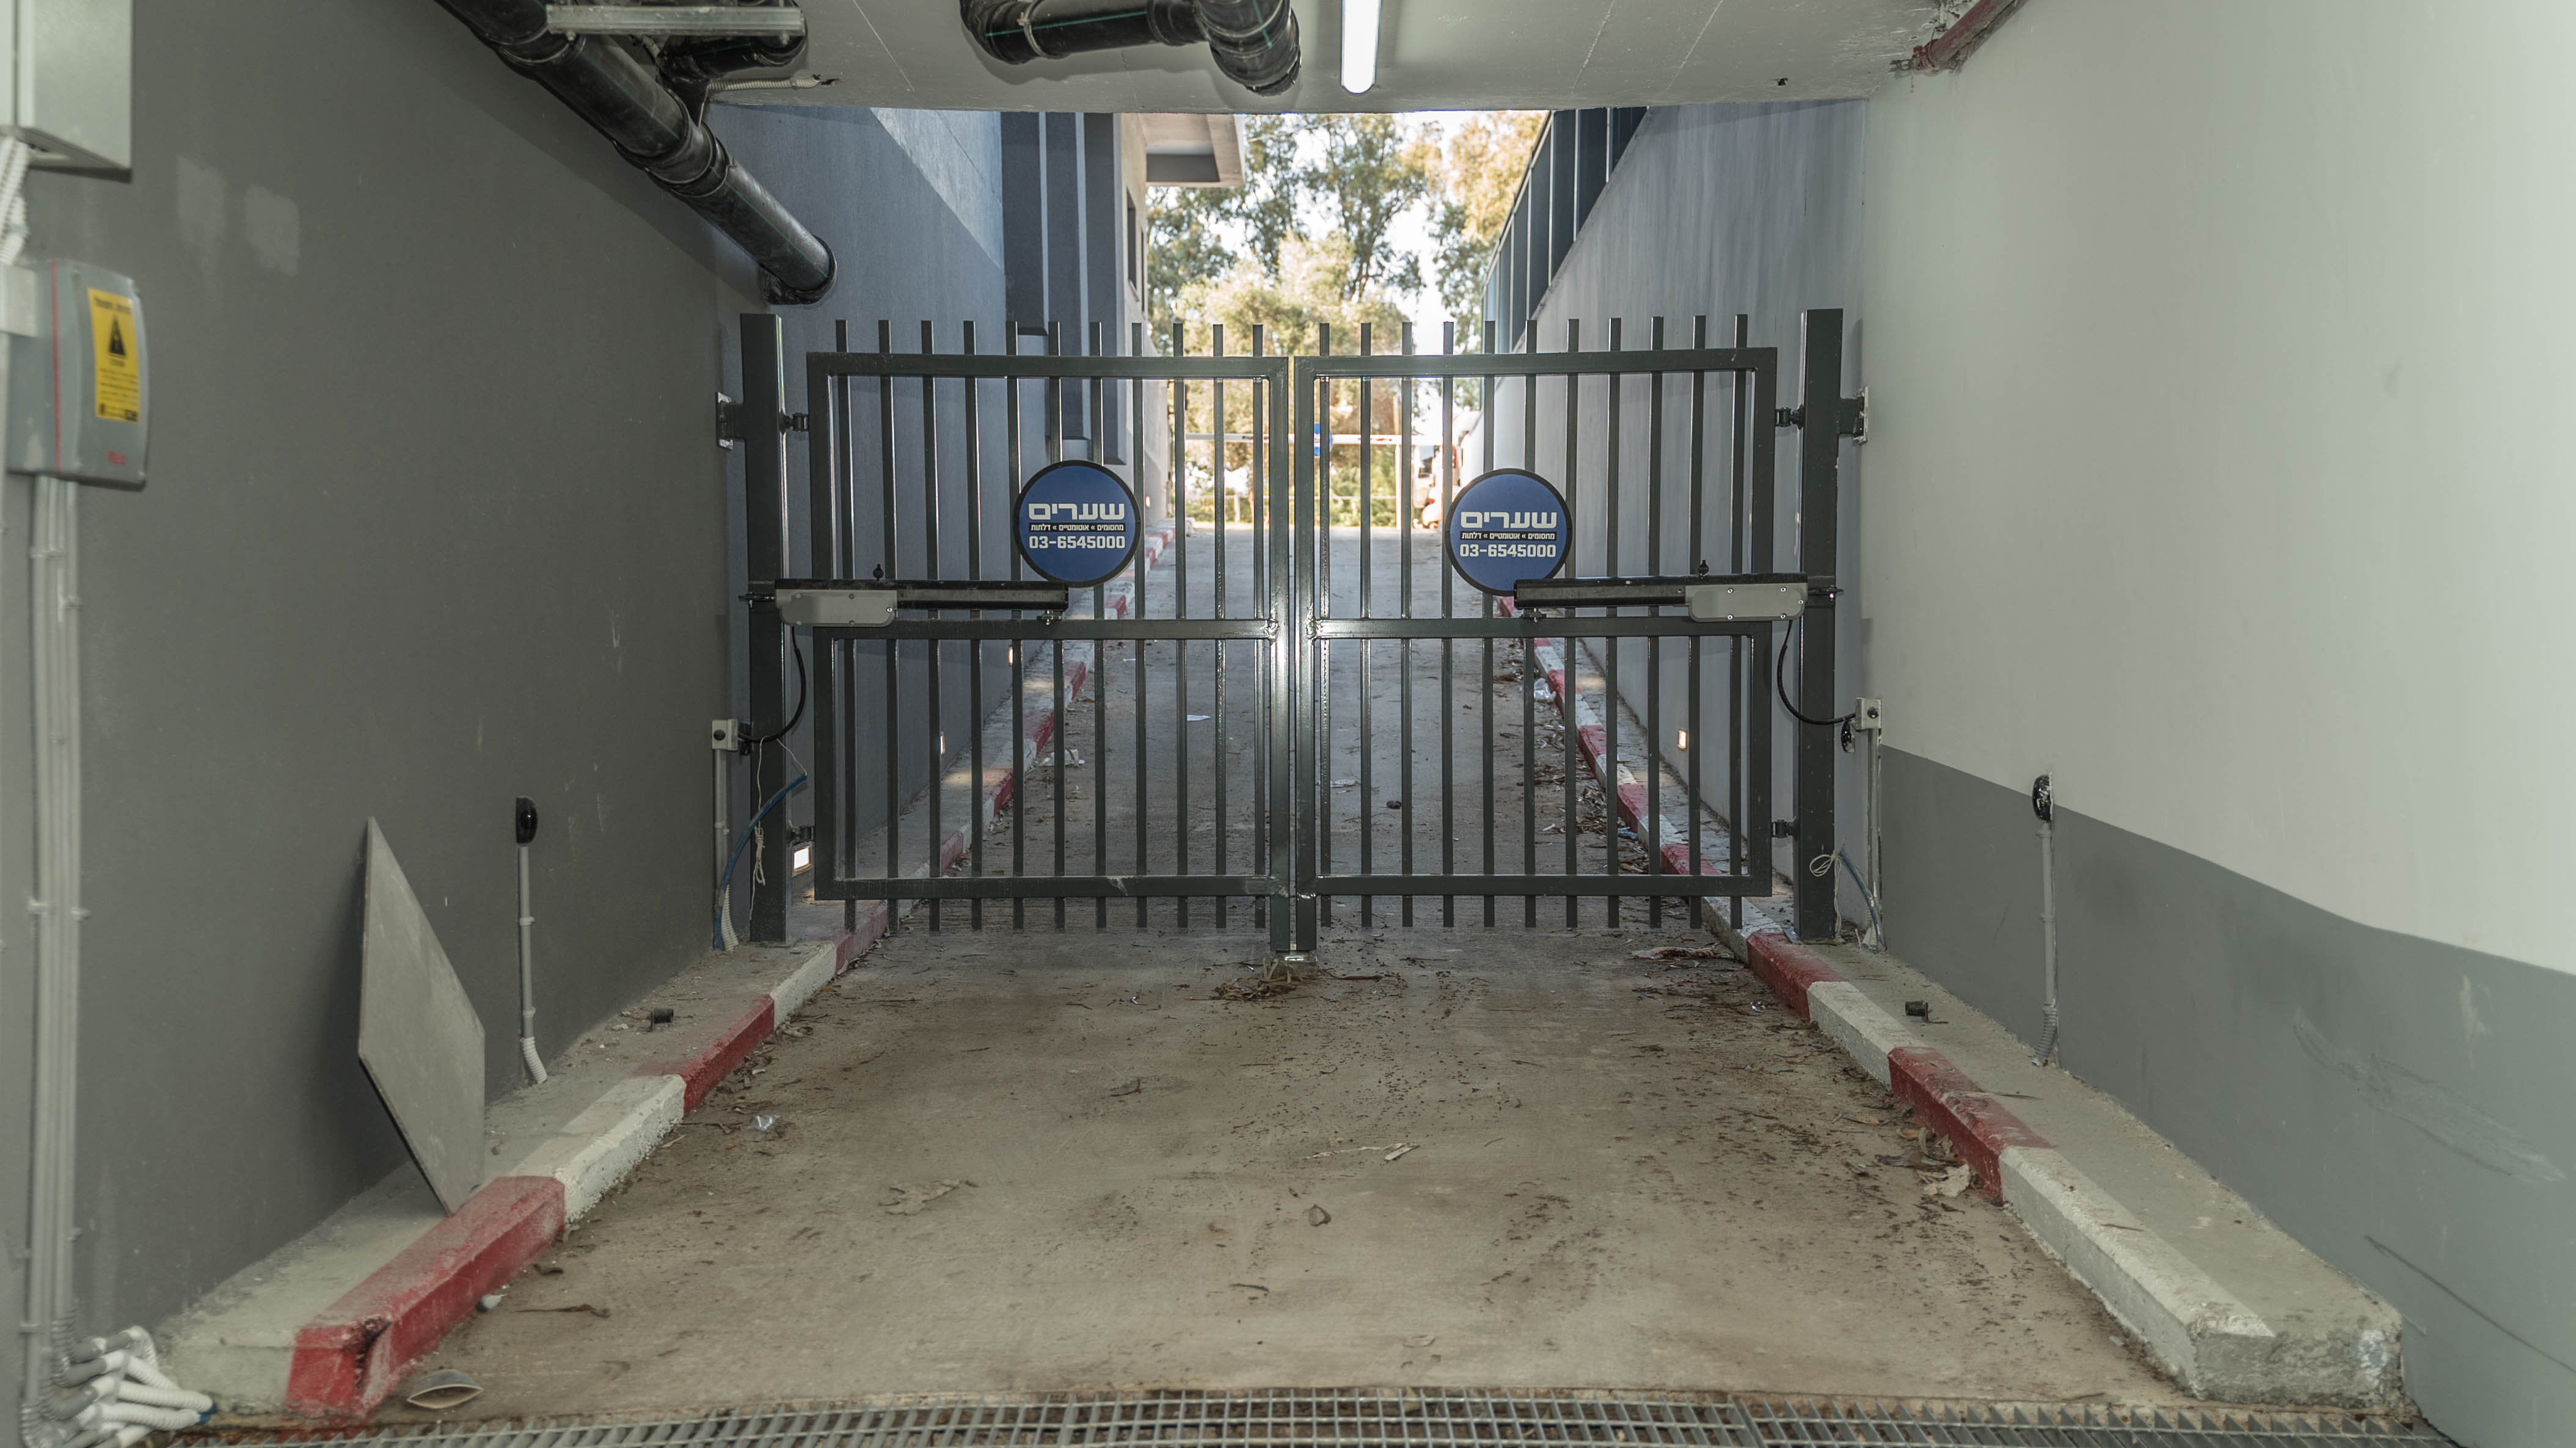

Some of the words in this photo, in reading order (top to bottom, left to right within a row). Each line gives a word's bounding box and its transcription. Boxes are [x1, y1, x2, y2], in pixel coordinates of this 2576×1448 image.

[1029, 503, 1125, 520] שערים
[1461, 512, 1557, 528] שערים
[1029, 536, 1125, 549] 03-6545000
[1460, 544, 1556, 557] 03-6545000
